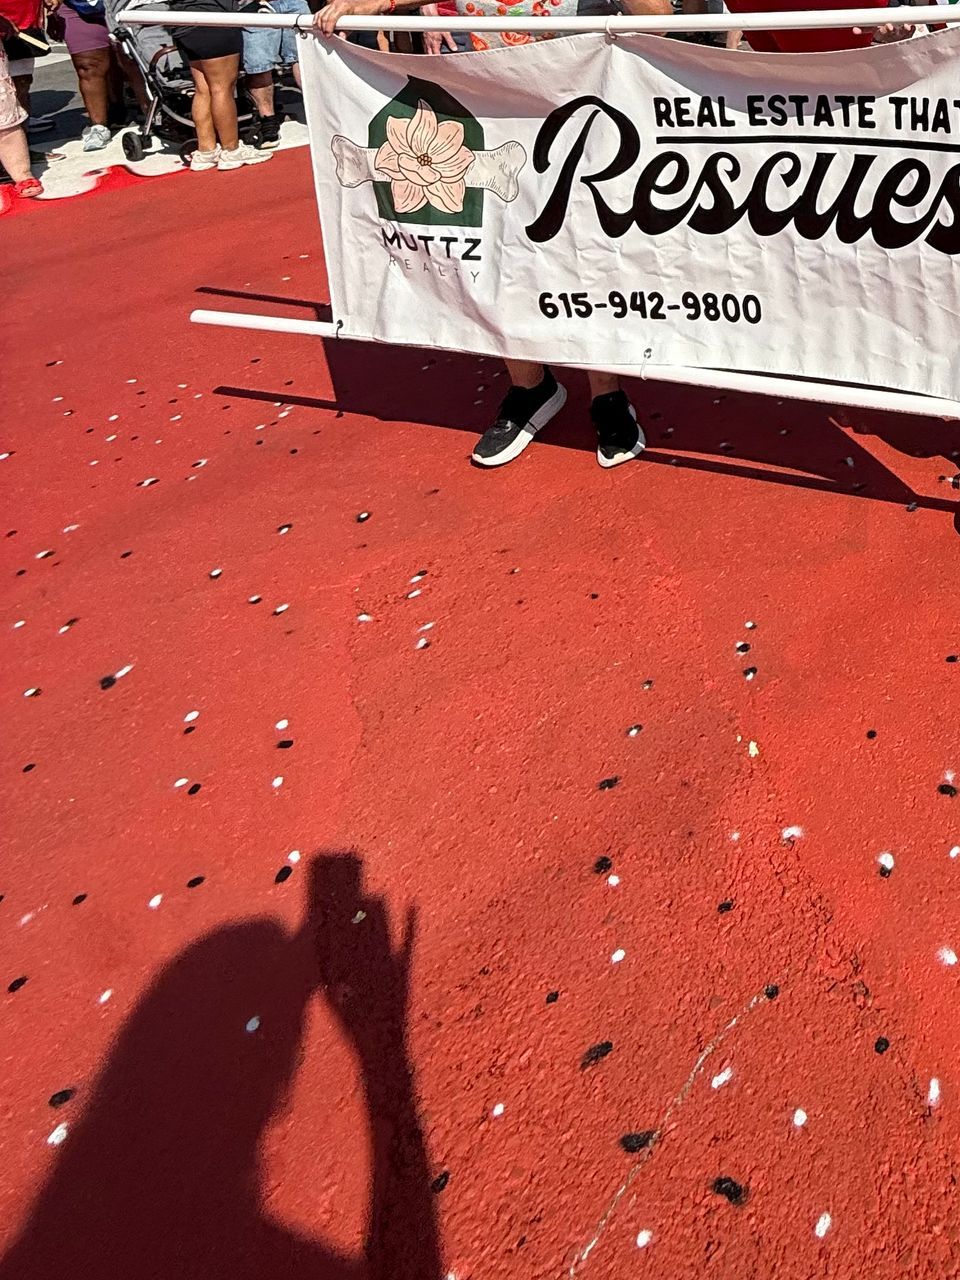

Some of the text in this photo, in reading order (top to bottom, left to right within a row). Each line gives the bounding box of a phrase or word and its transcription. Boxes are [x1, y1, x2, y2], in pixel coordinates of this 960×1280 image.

[654, 96, 736, 128] REAL
[747, 95, 877, 129] ESTATE
[381, 227, 482, 261] MUTTZ
[389, 254, 480, 283] REALTY
[538, 291, 762, 325] 615-942-9800
